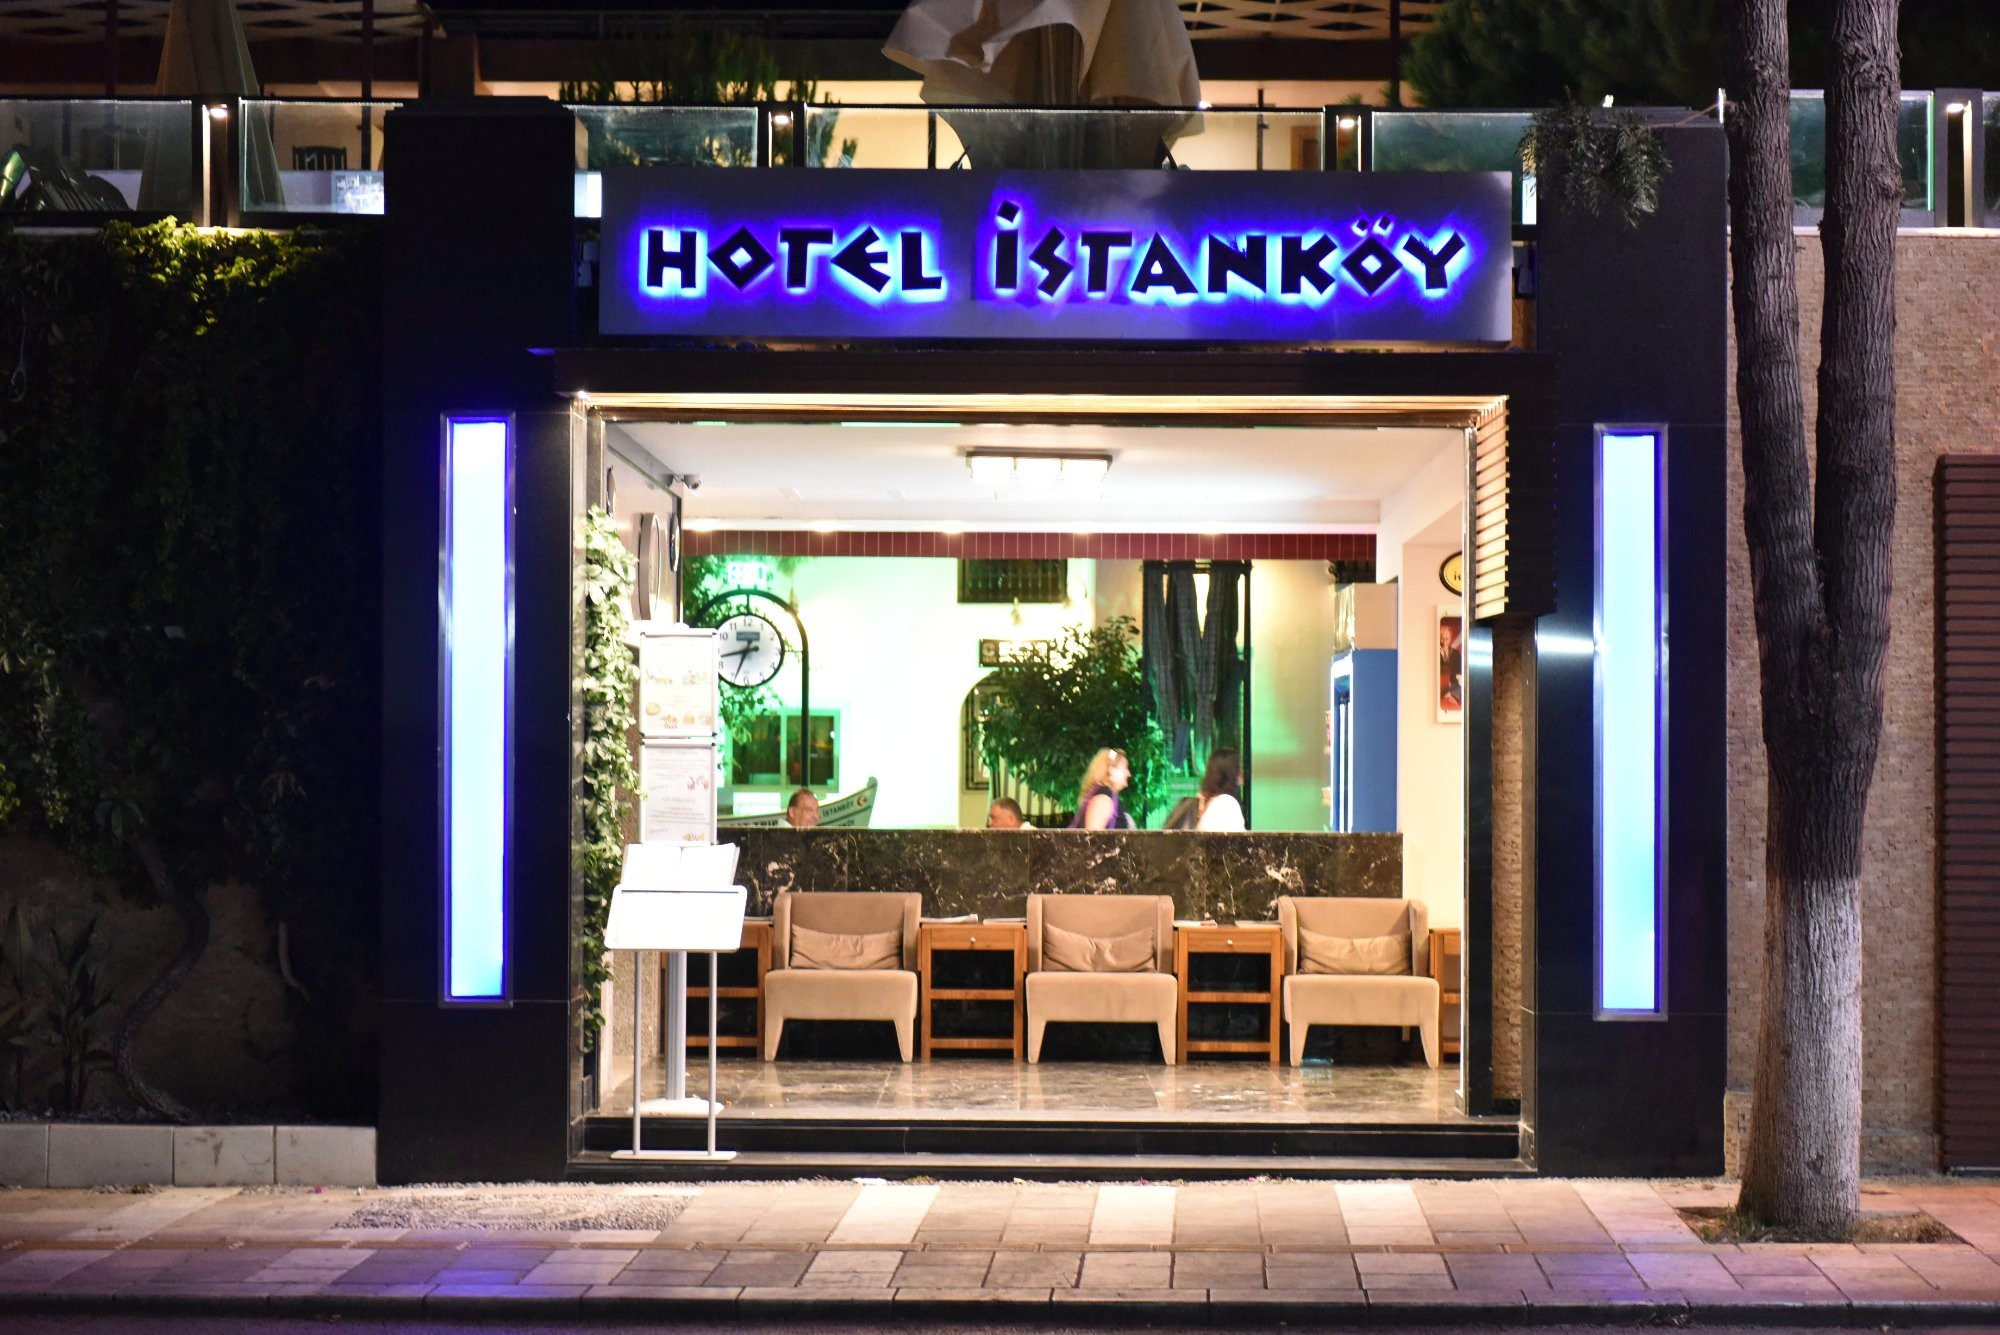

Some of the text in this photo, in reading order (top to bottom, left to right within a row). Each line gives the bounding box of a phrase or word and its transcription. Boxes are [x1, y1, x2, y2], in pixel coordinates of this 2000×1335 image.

[646, 199, 1467, 298] HOTEL İSTANKÖY
[729, 622, 737, 631] 11
[743, 617, 753, 627] 12
